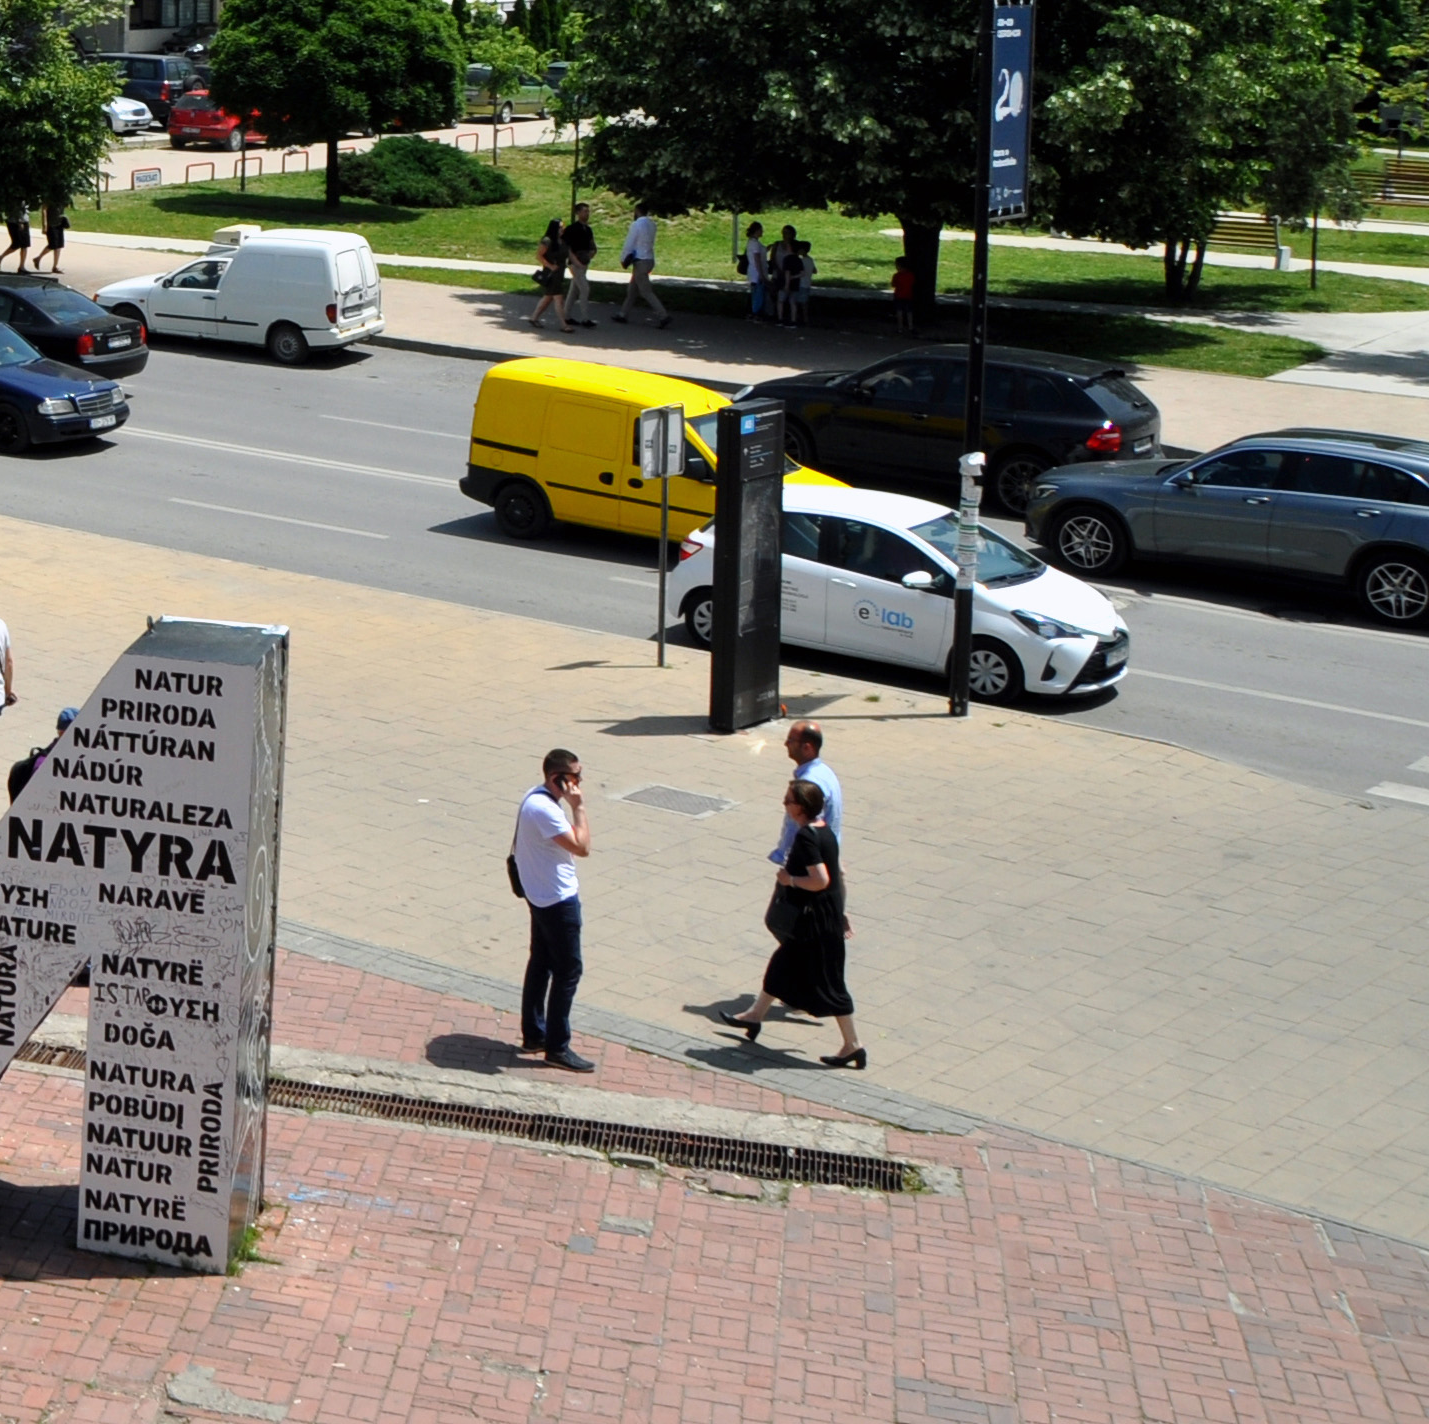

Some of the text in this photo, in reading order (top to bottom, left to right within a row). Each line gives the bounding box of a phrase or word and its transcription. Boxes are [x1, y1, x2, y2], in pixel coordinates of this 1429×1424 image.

[881, 608, 914, 629] lab
[135, 668, 224, 698] NATUR
[101, 697, 216, 729] PRIRODA
[73, 724, 215, 762] NÁTTÚRAN
[52, 754, 143, 788] NÁDÚR
[59, 791, 233, 829] NATURALEZA
[7, 816, 237, 885] NATYRA
[98, 883, 205, 915] NARAVE
[101, 954, 203, 987] NATYRË
[104, 1023, 175, 1052] DOĞA
[90, 1060, 196, 1094] NATURA
[87, 1122, 192, 1158] NATUUR
[197, 1081, 223, 1194] PRIRODA
[86, 1153, 172, 1186] NATUR
[85, 1189, 186, 1222] NATYRË
[84, 1219, 213, 1257] ПРИРОДА
